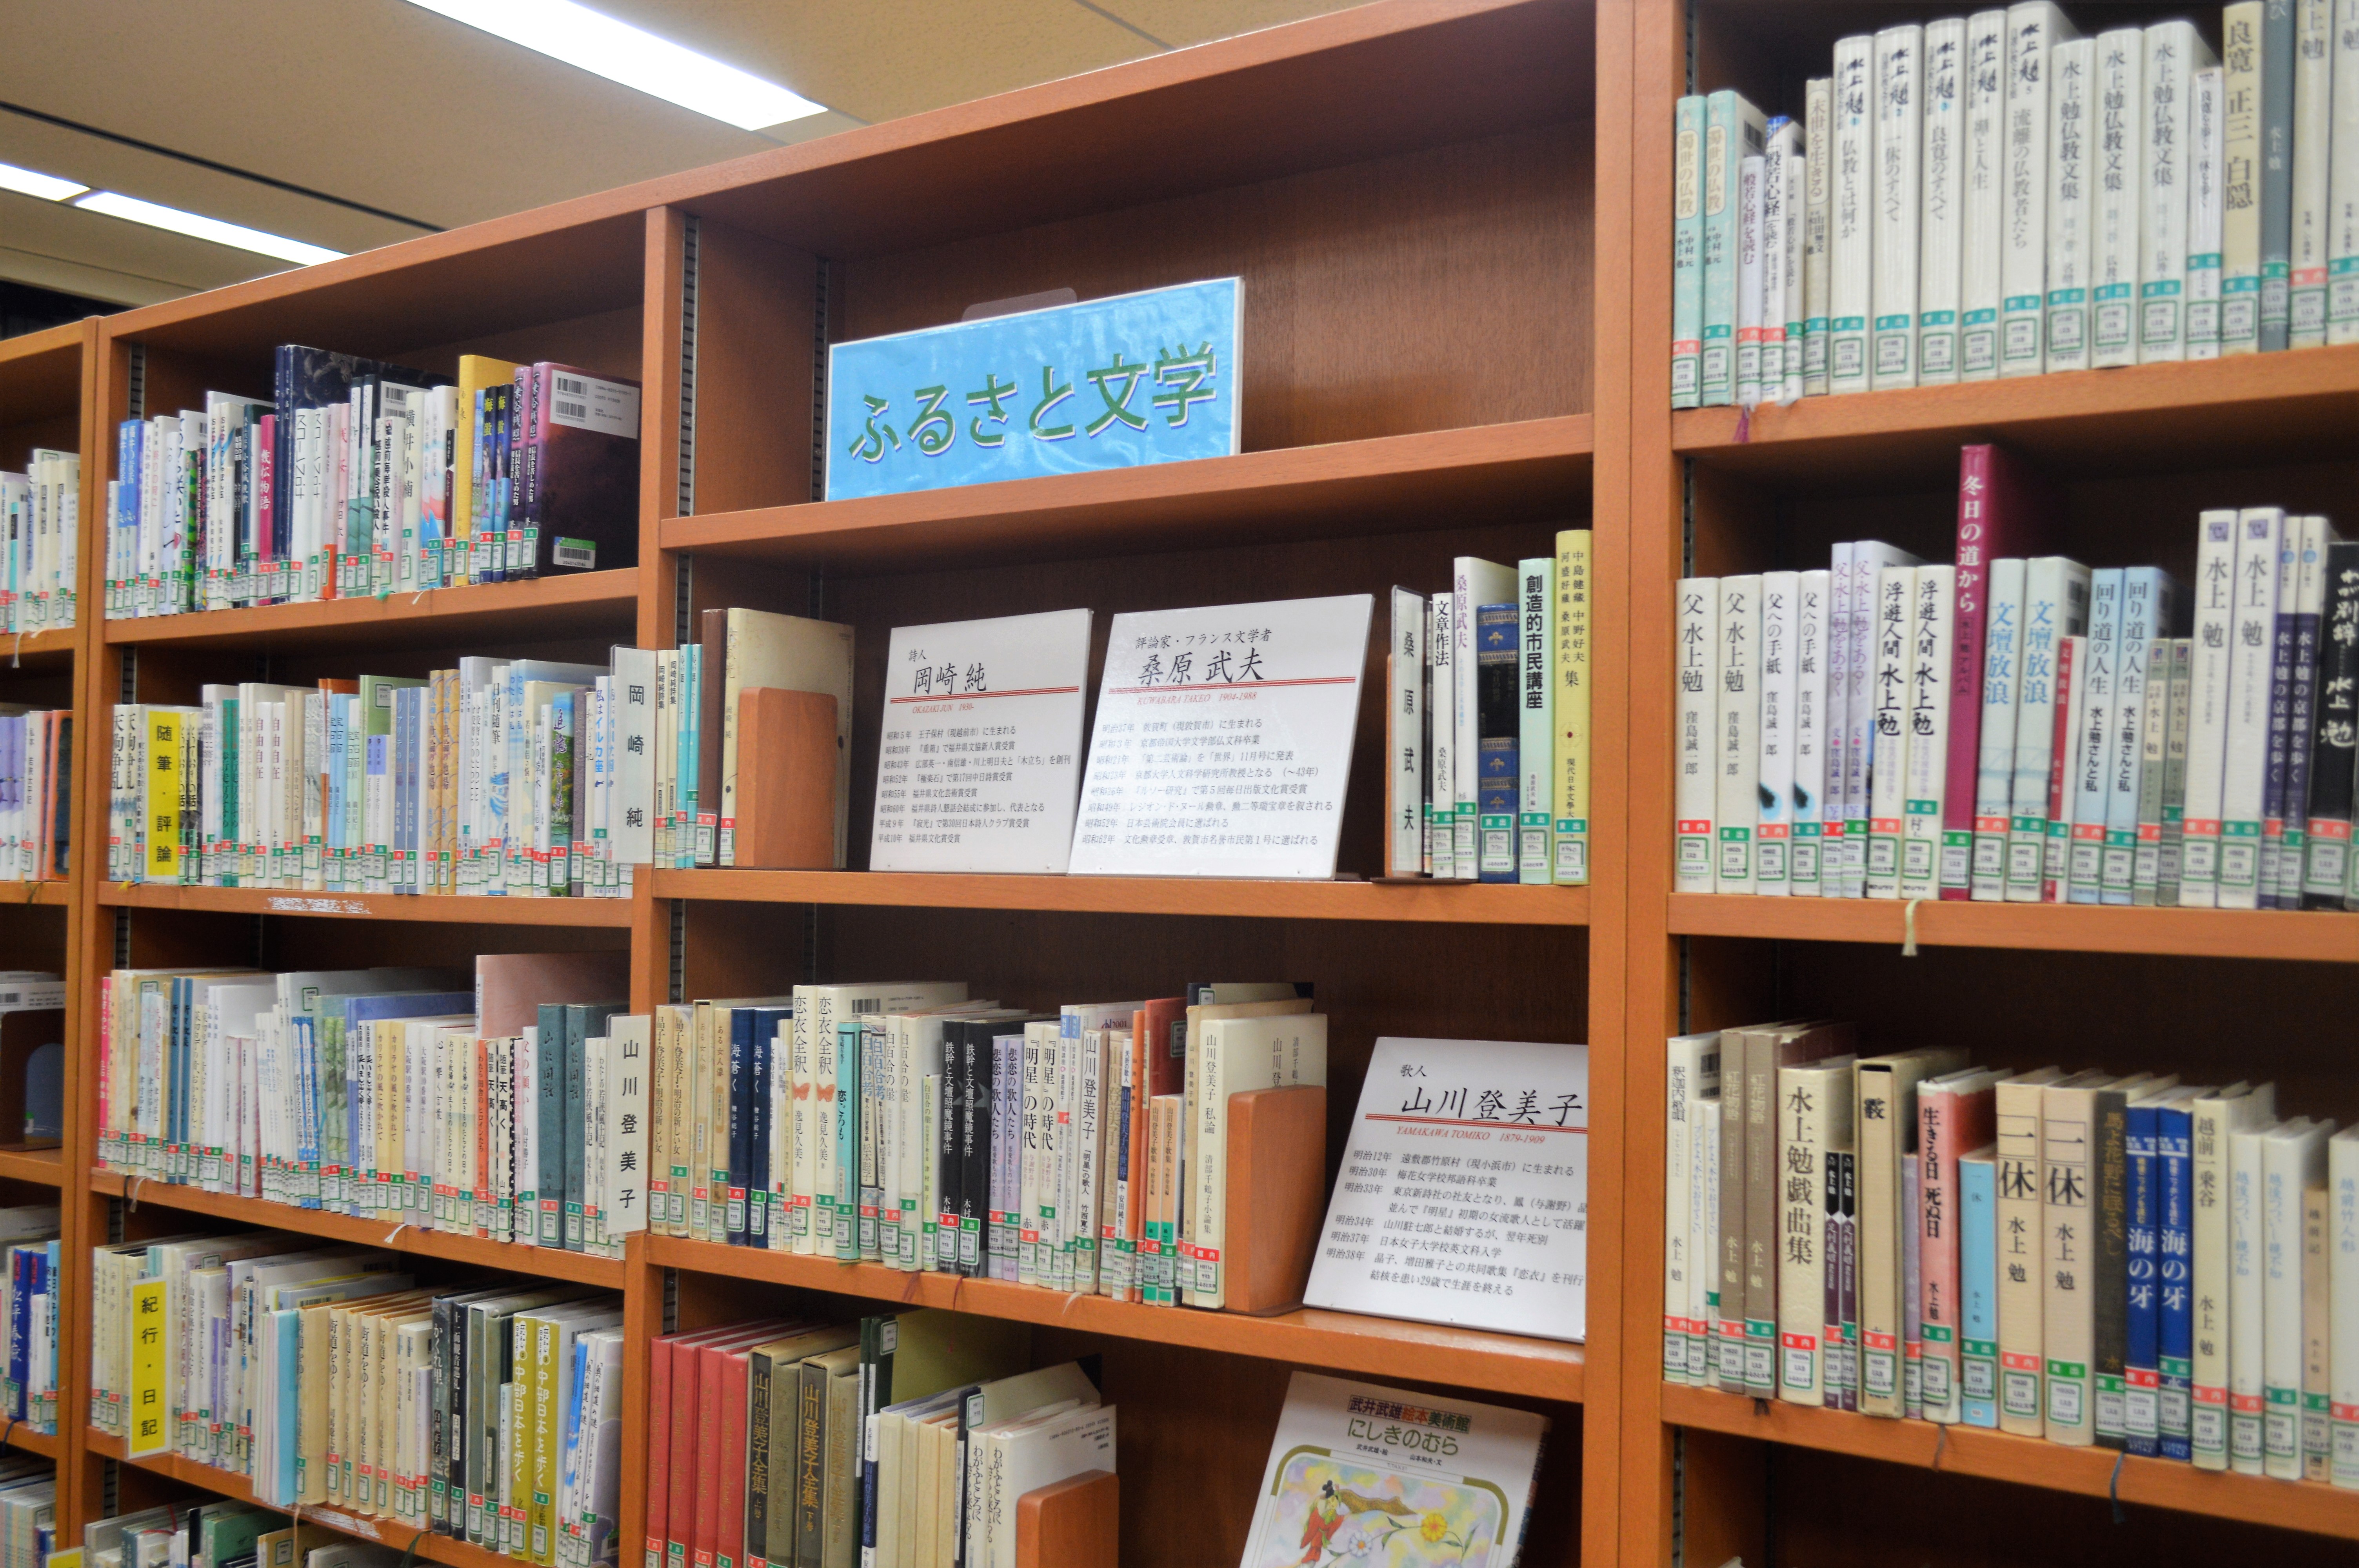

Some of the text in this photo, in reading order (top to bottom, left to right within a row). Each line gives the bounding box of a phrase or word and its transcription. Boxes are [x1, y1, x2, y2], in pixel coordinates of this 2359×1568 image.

[2060, 61, 2081, 201] 水上勉仏教文集
[849, 341, 1217, 464] ふるさと文学
[1958, 475, 1984, 612] 冬日の道から
[1456, 574, 1467, 649] 桑原武夫
[1683, 594, 1704, 615] 父
[1765, 594, 1783, 675] 父への手紙
[2203, 557, 2228, 648] 水上勉
[909, 650, 927, 662] 詩人
[1135, 628, 1272, 650] 評論家・フランス文学者
[1138, 647, 1265, 687] 桑原武夫
[1526, 575, 1543, 709] 創造的市民講座
[1682, 624, 1704, 693] 水上勉
[2024, 601, 2056, 704] 文壇放浪
[2092, 584, 2114, 695] 回り道の人生
[912, 704, 940, 714] OKAZAKI
[940, 704, 954, 712] JUN
[913, 662, 987, 695] 岡崎純
[1137, 692, 1258, 705] KUWABARA TAKEO 1904-1988
[1436, 601, 1449, 792] 文章作法 桑原武夫
[1565, 670, 1579, 687] 集
[627, 685, 644, 828] 岡崎純
[1404, 632, 1414, 831] 桑原武夫
[157, 725, 172, 862] 随筆・評論
[913, 788, 978, 799] 福井県文化芸術賞受賞
[909, 833, 961, 844] 福井県文化賞受賞
[793, 996, 807, 1074] 恋衣全釈
[1083, 1035, 1097, 1140] 山川登美子
[1400, 1064, 1427, 1077] 歌人
[619, 1040, 639, 1209] 山川登美子
[1396, 1126, 1545, 1144] YAMAKAWA TOMIKO 1879-1909
[1402, 1087, 1583, 1127] 山川登美子
[1345, 1182, 1383, 1194] 明治33年
[1349, 1166, 1387, 1178] 明治30年
[1354, 1150, 1392, 1162] 明治12年
[1786, 1086, 1814, 1265] 水上勉戯曲集
[1924, 1106, 1942, 1238] 生きる日 死ぬ日
[1326, 1248, 1365, 1261] 明治38年
[1331, 1231, 1370, 1244] 明治37年
[1335, 1214, 1374, 1227] 明治34年
[2055, 1223, 2075, 1290] 水上勉
[2161, 1228, 2188, 1310] 海の牙
[141, 1296, 158, 1437] 紀行・日記
[1348, 1417, 1459, 1456] にしきのむら
